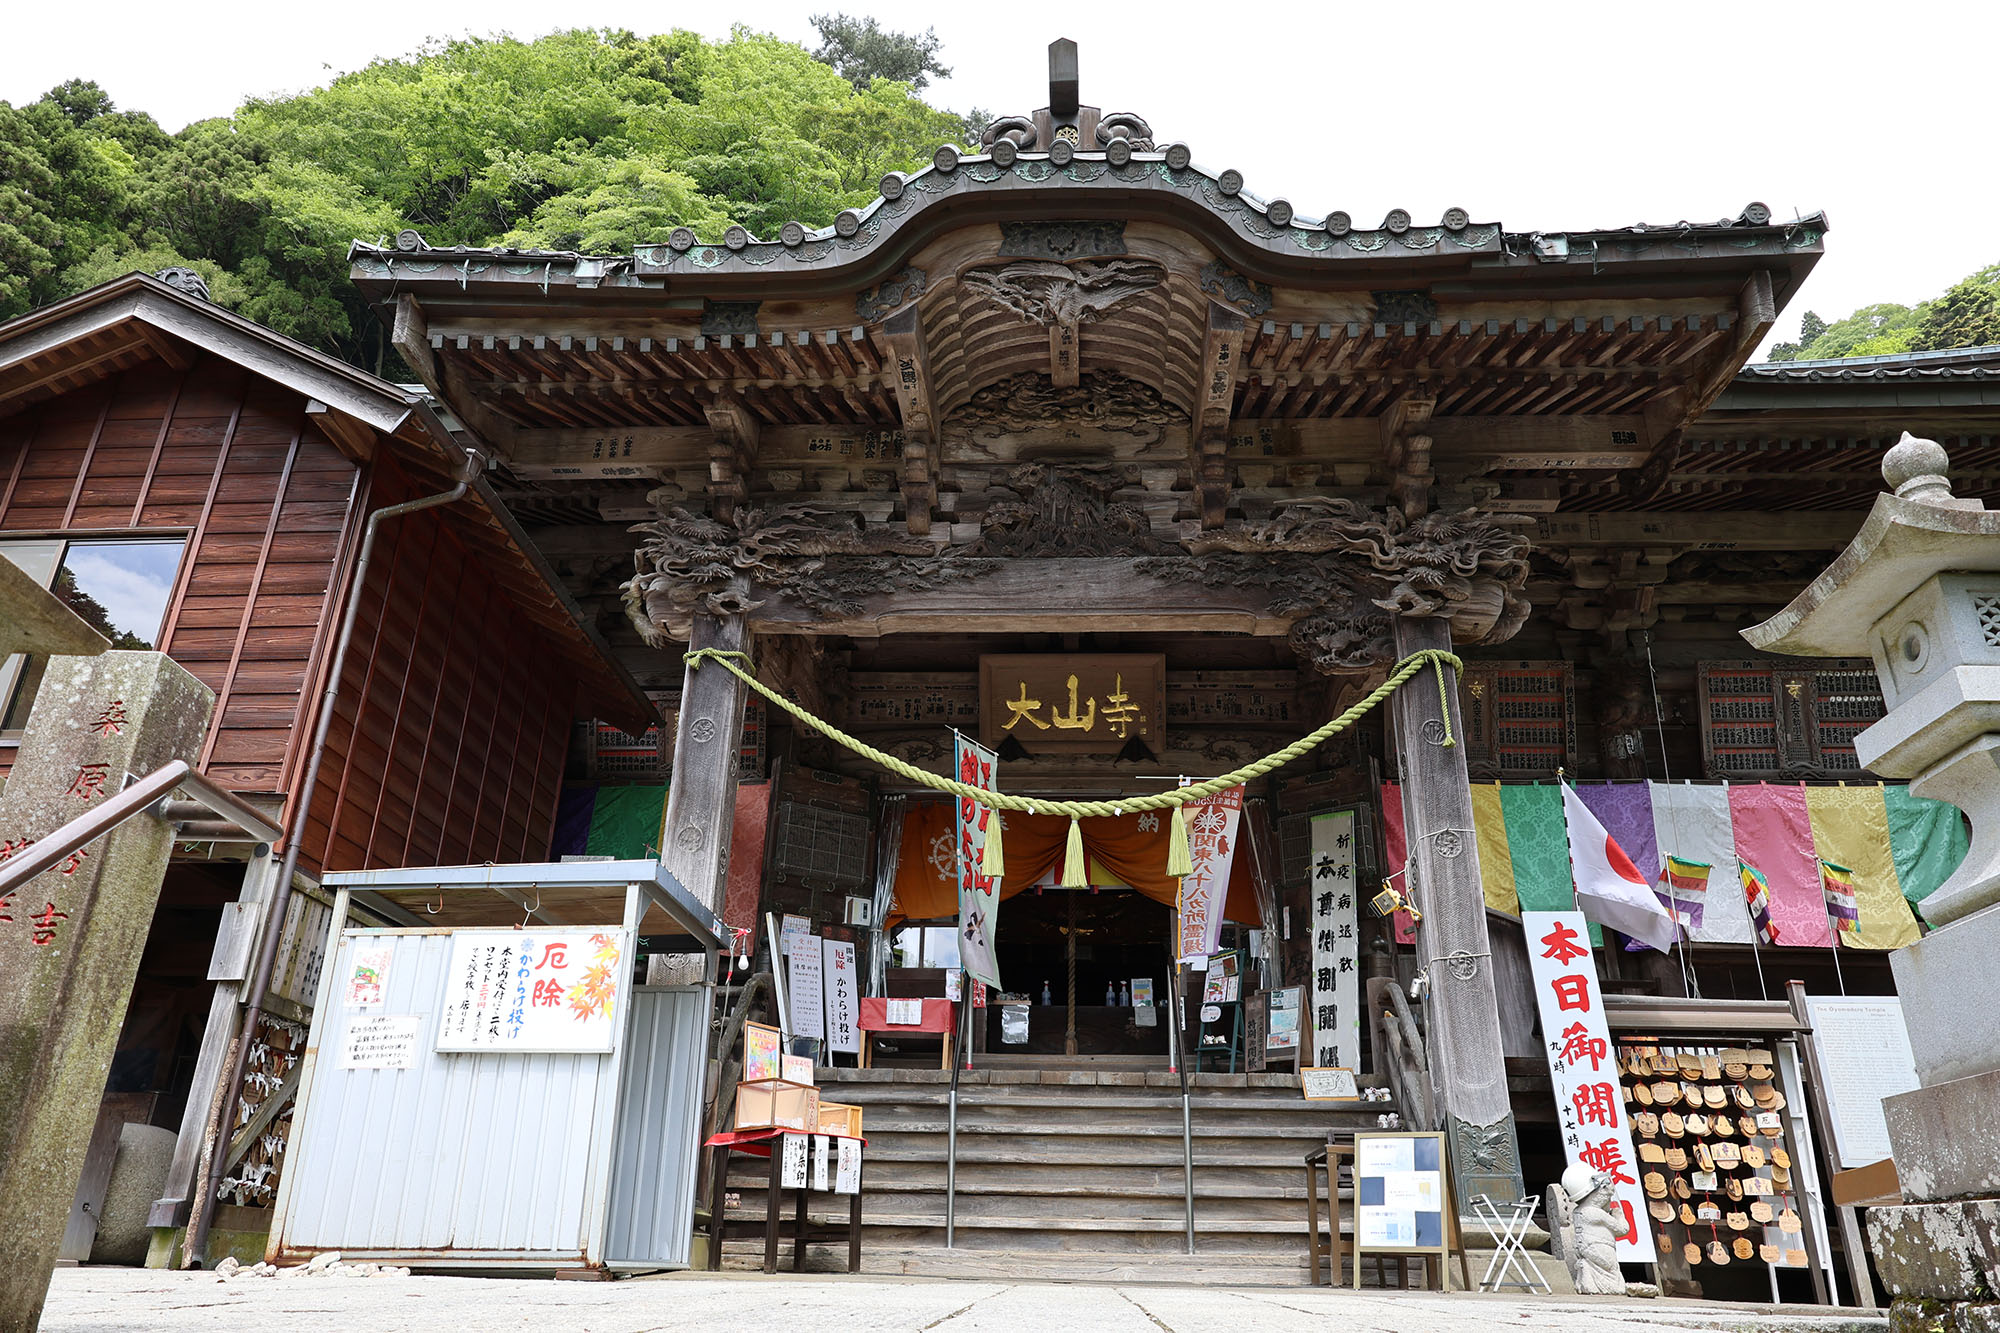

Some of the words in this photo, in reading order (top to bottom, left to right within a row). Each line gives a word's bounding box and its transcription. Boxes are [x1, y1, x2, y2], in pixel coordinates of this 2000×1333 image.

[1001, 672, 1141, 739] 大山寺
[1138, 813, 1160, 833] 納
[532, 942, 570, 1008] 厄除
[835, 949, 846, 970] 厄除
[507, 954, 533, 1039] かわらけ投げ
[837, 977, 850, 1045] かわらけ投げ
